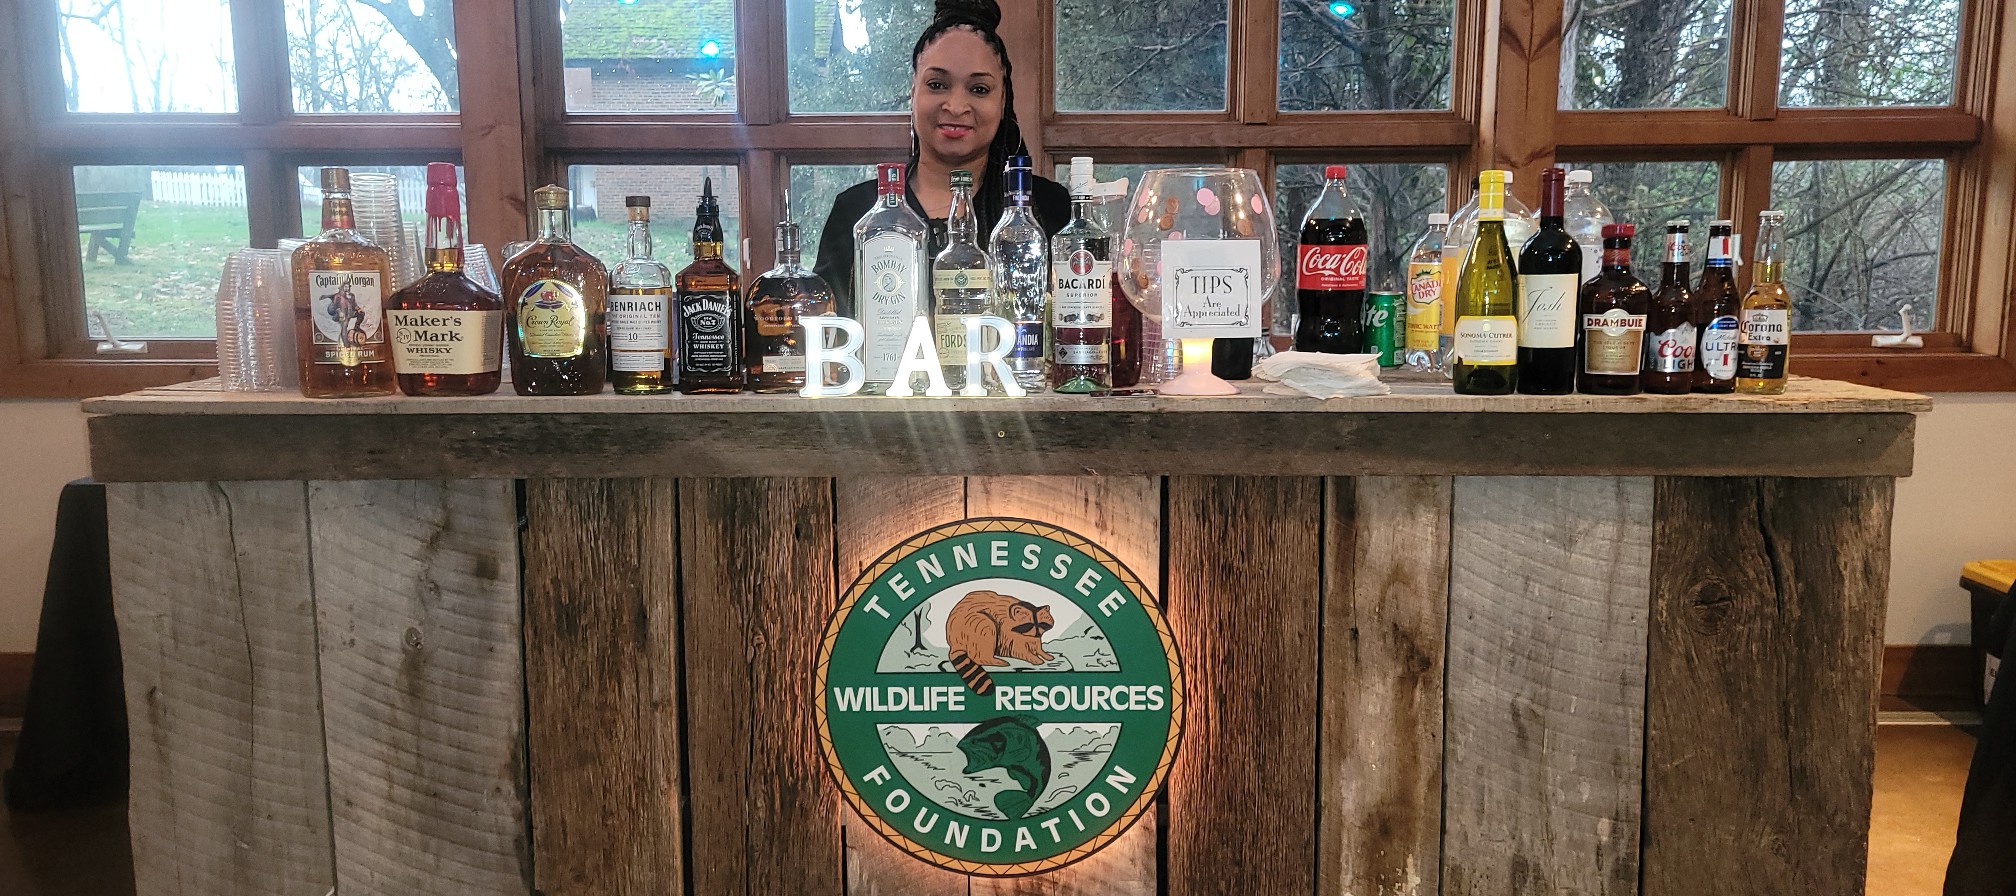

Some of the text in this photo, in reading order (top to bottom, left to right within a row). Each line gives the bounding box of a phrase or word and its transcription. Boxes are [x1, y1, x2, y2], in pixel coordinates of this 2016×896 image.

[871, 260, 907, 274] BOMBAY
[316, 274, 374, 288] Captain Morgan
[1059, 275, 1105, 289] BACARDÍ
[1191, 276, 1232, 294] TIPS
[872, 291, 906, 305] DRY GIN
[1418, 289, 1436, 299] DRY
[1203, 296, 1222, 308] Are
[1522, 286, 1566, 324] Josh
[683, 302, 702, 317] JACK
[1184, 304, 1240, 318] Appreciated
[394, 315, 462, 326] Maker's
[526, 315, 575, 328] Crown Royal
[1587, 318, 1643, 327] DRAMBUIE
[1740, 320, 1782, 333] Corona
[414, 330, 462, 342] Mark
[1748, 333, 1771, 341] Extra
[1706, 342, 1738, 351] ULTR
[799, 316, 1027, 397] BAR
[1663, 359, 1694, 369] LIGH
[863, 540, 1127, 620] TENNESSEE
[834, 685, 1164, 712] WILDLIFE RESOURCES
[862, 764, 1137, 853] FOUNDATION
